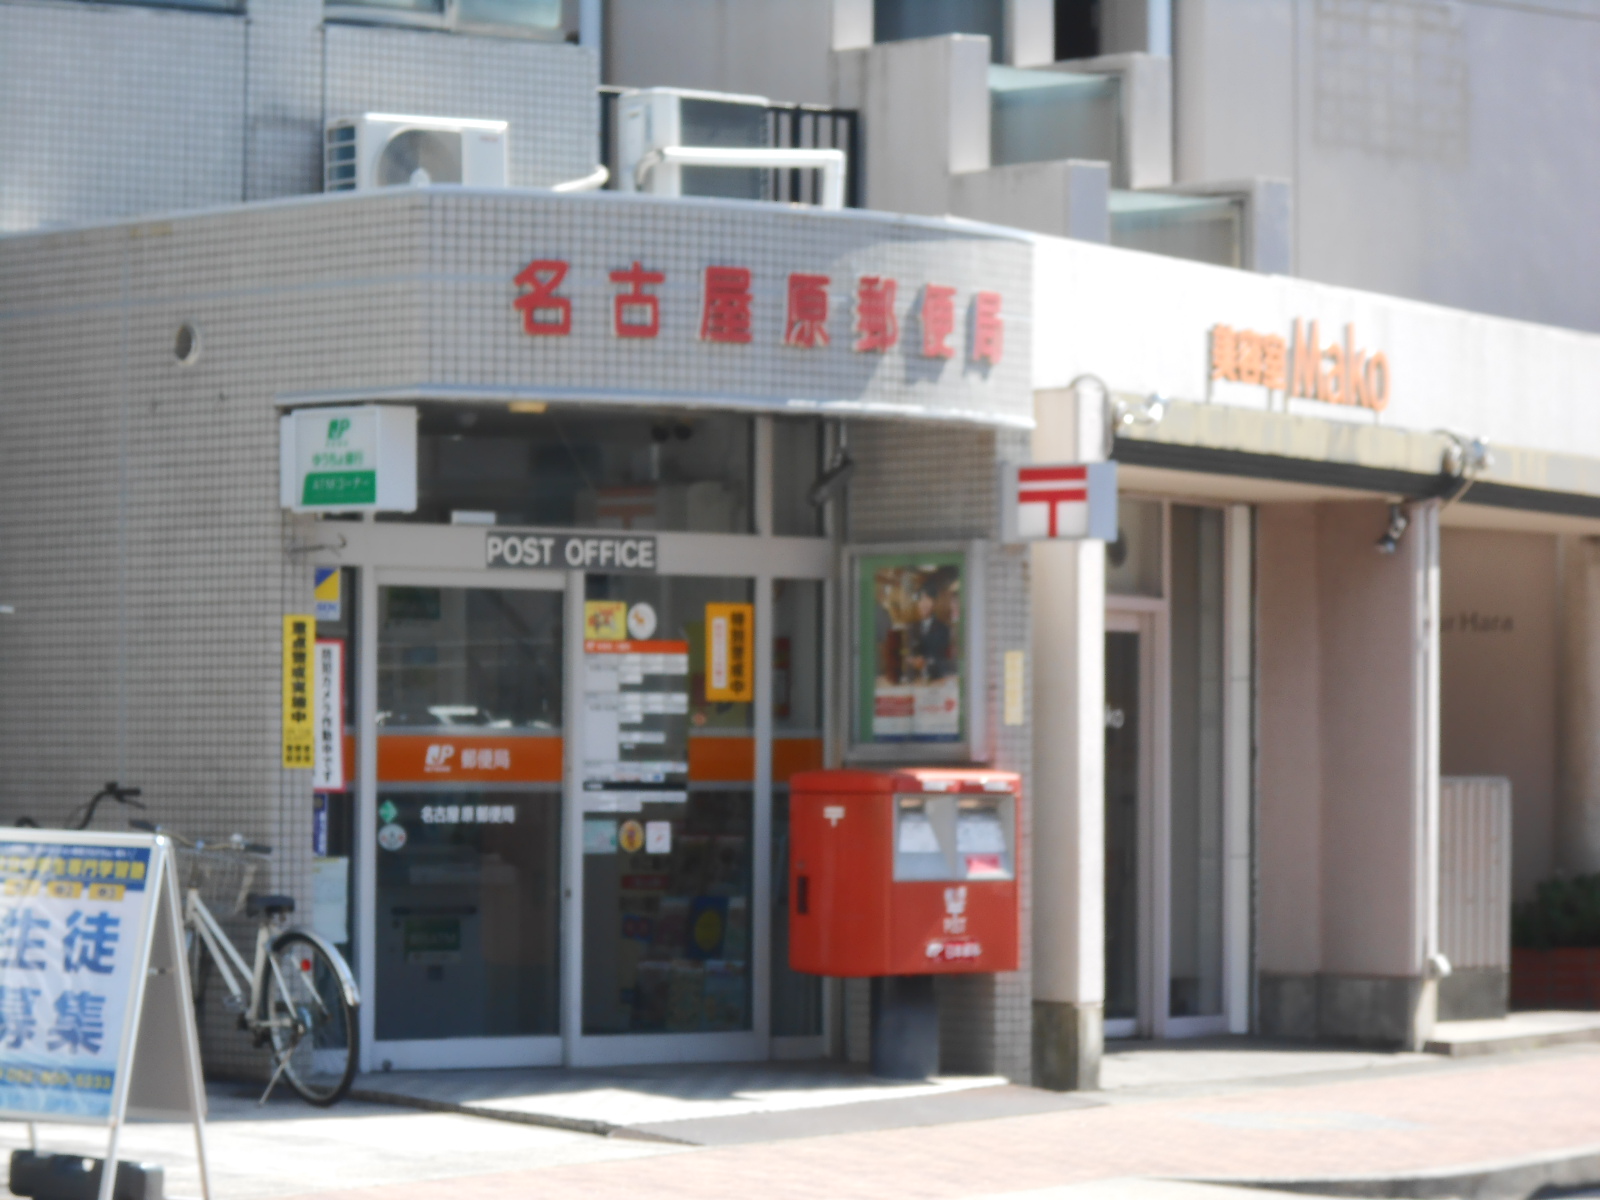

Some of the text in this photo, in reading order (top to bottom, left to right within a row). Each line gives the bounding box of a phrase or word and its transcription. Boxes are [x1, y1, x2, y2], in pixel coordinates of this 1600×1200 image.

[513, 259, 1004, 366] 名古屋原郵便局
[1290, 315, 1390, 413] Mako
[487, 535, 654, 568] POST OFFICE
[460, 748, 511, 770] 郵便局
